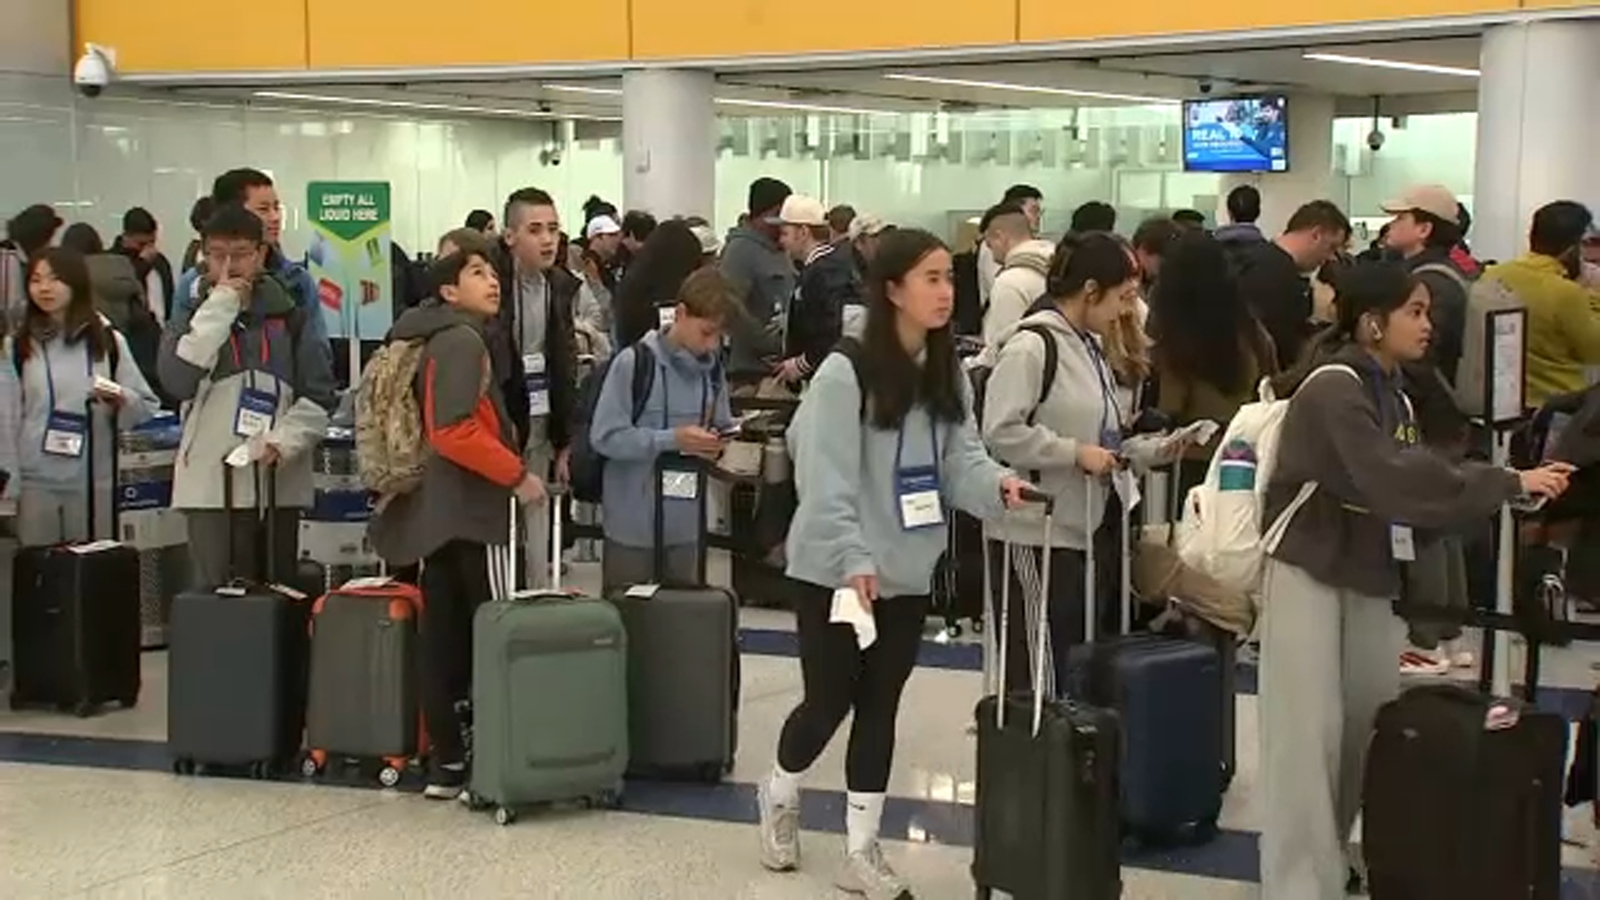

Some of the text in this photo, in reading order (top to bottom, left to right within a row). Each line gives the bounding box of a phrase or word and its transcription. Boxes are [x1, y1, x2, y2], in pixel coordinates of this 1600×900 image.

[321, 193, 376, 206] EMPTY ALL
[319, 207, 379, 221] LIQUID HERE
